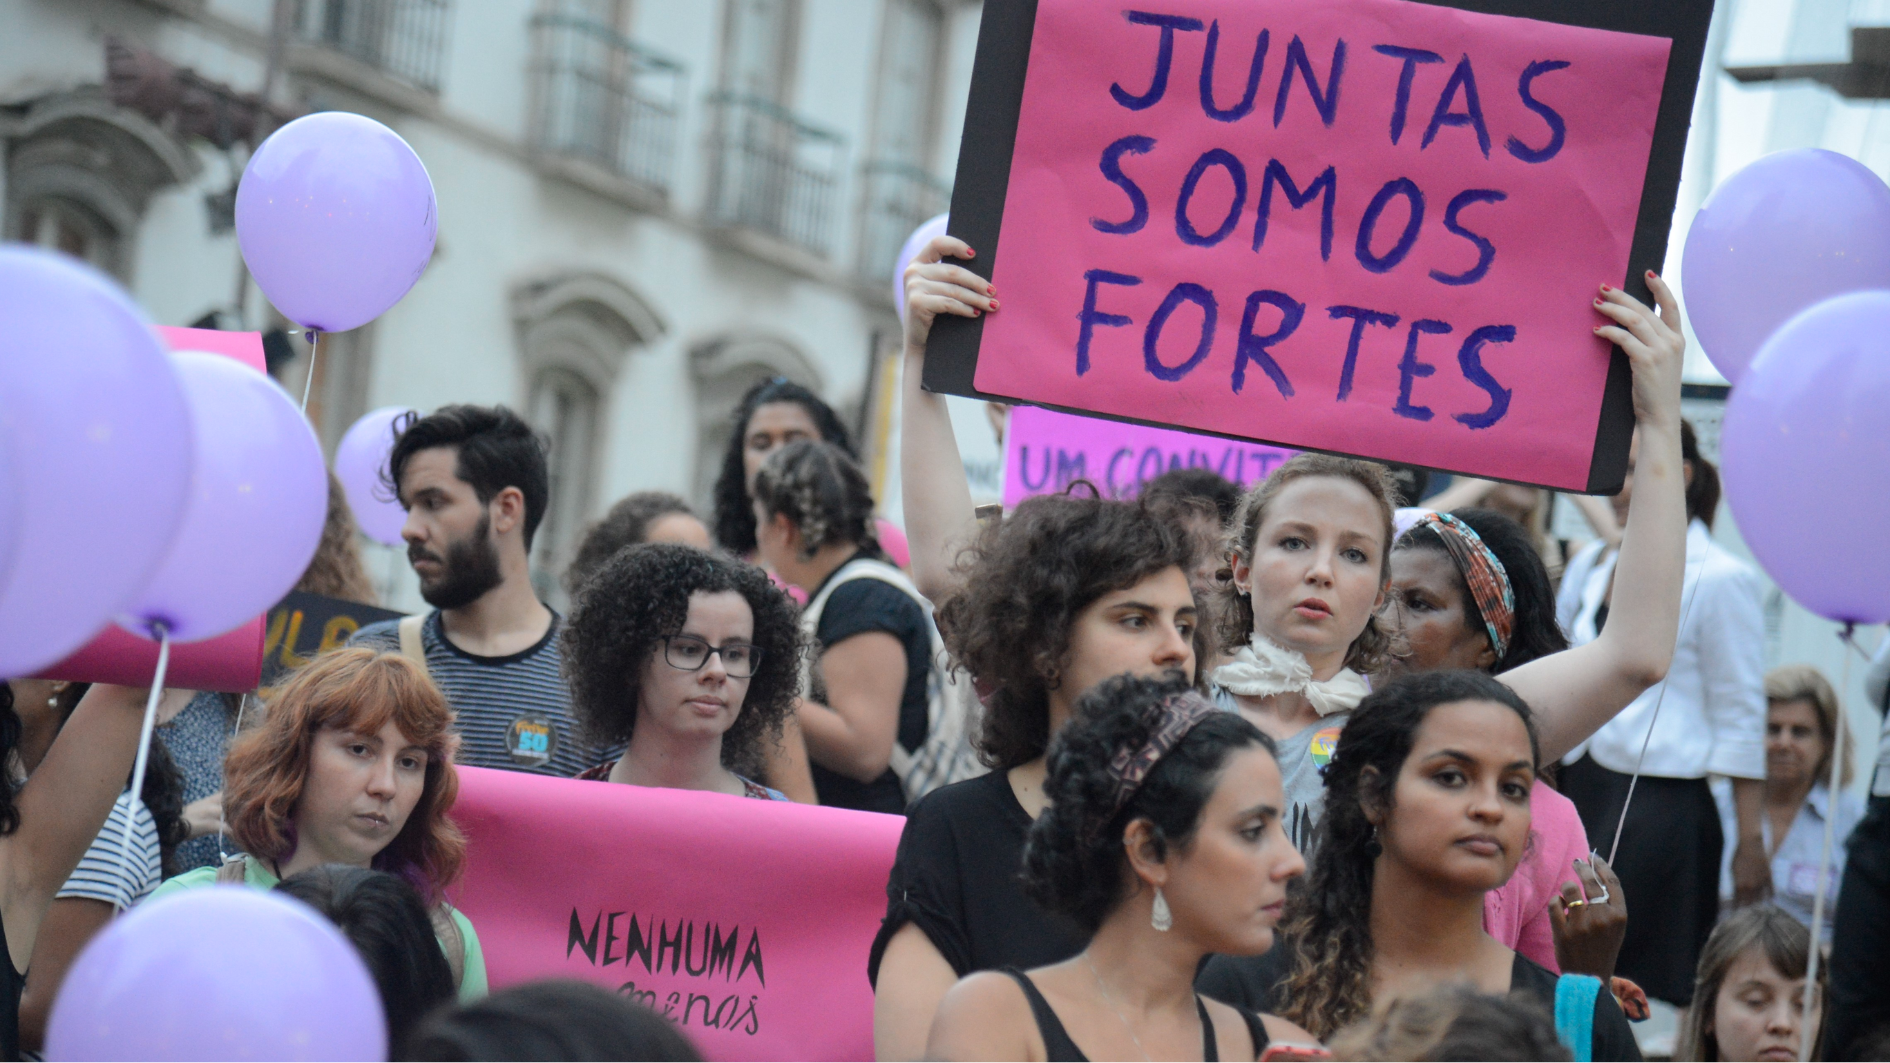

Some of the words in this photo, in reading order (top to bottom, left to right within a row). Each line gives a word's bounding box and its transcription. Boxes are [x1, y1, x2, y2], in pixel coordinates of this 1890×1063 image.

[1109, 9, 1571, 164] JUNTAS
[1090, 134, 1507, 286] SOMOS
[1075, 267, 1517, 431] FORTES
[1019, 445, 1087, 494] UM
[566, 906, 765, 989] NENHUMA
